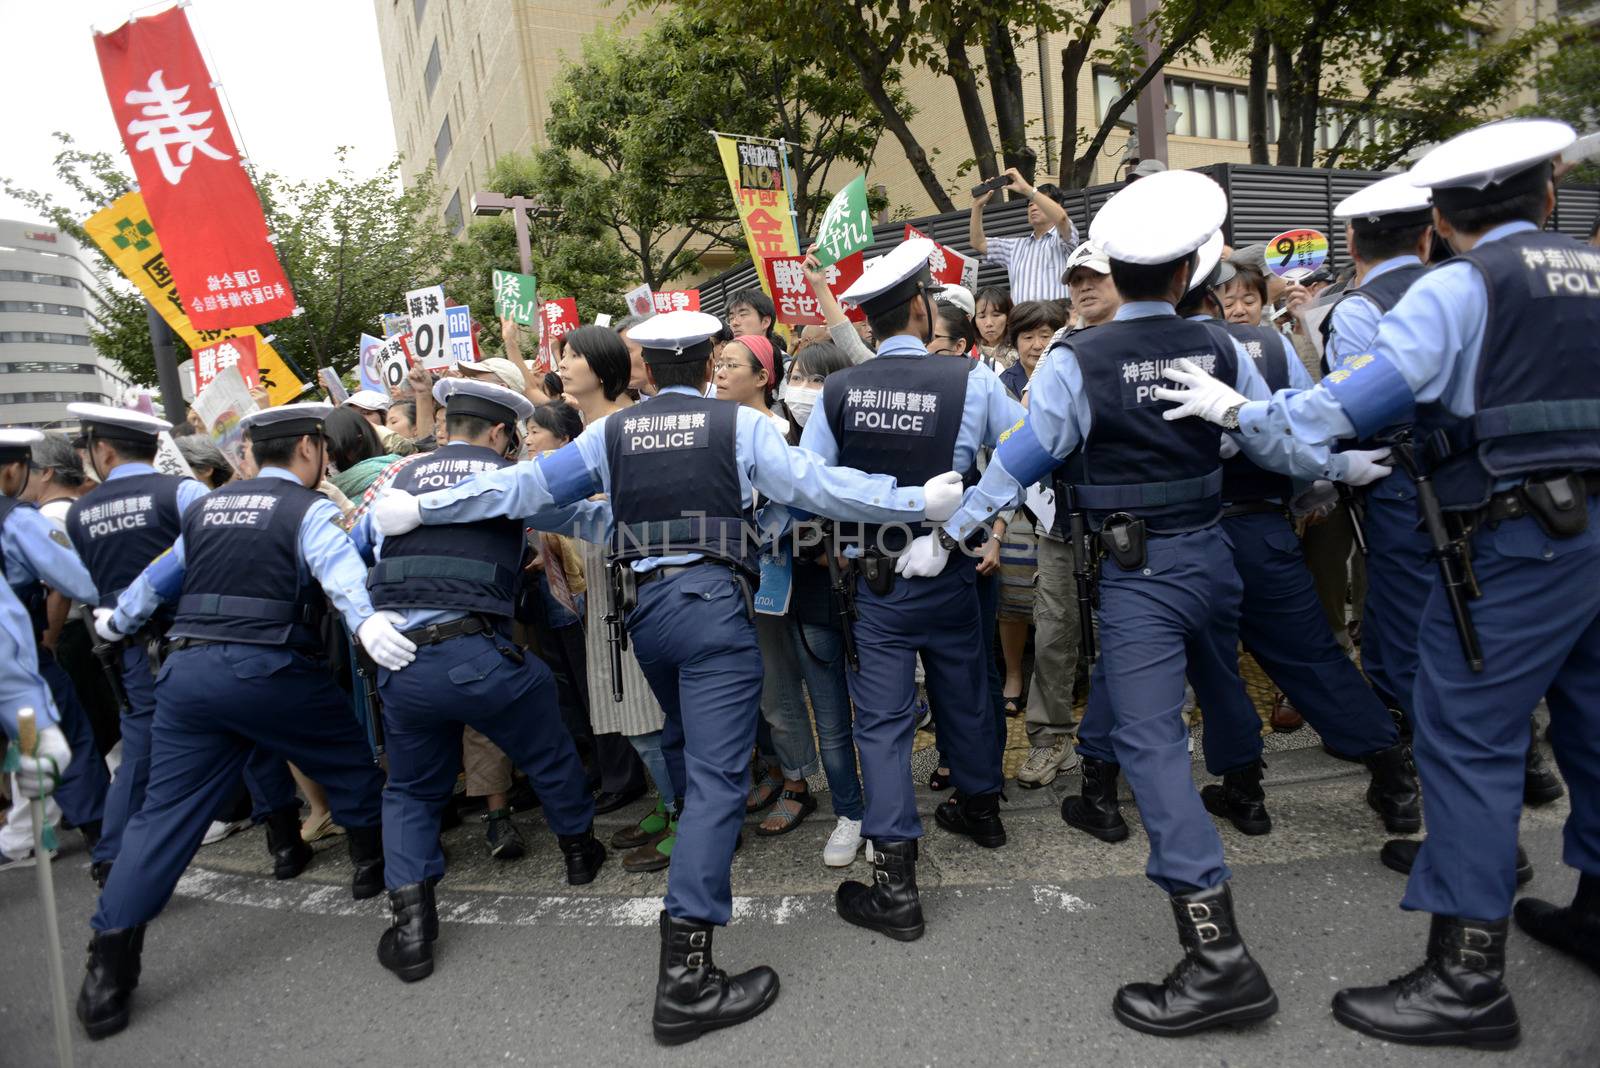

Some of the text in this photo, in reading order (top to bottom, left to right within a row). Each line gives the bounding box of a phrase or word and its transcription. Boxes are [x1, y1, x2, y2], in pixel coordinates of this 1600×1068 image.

[1521, 248, 1600, 271] 神奈川県
[409, 294, 439, 318] 採決
[848, 388, 936, 413] 神奈川県警察
[624, 413, 705, 434] 神奈川県警察
[855, 411, 923, 431] POLICE
[631, 431, 694, 451] POLICE
[80, 496, 152, 525] 神奈川県警察
[203, 495, 277, 511] 神奈川県警察
[89, 513, 147, 538] POLICE
[203, 511, 259, 526] POLICE
